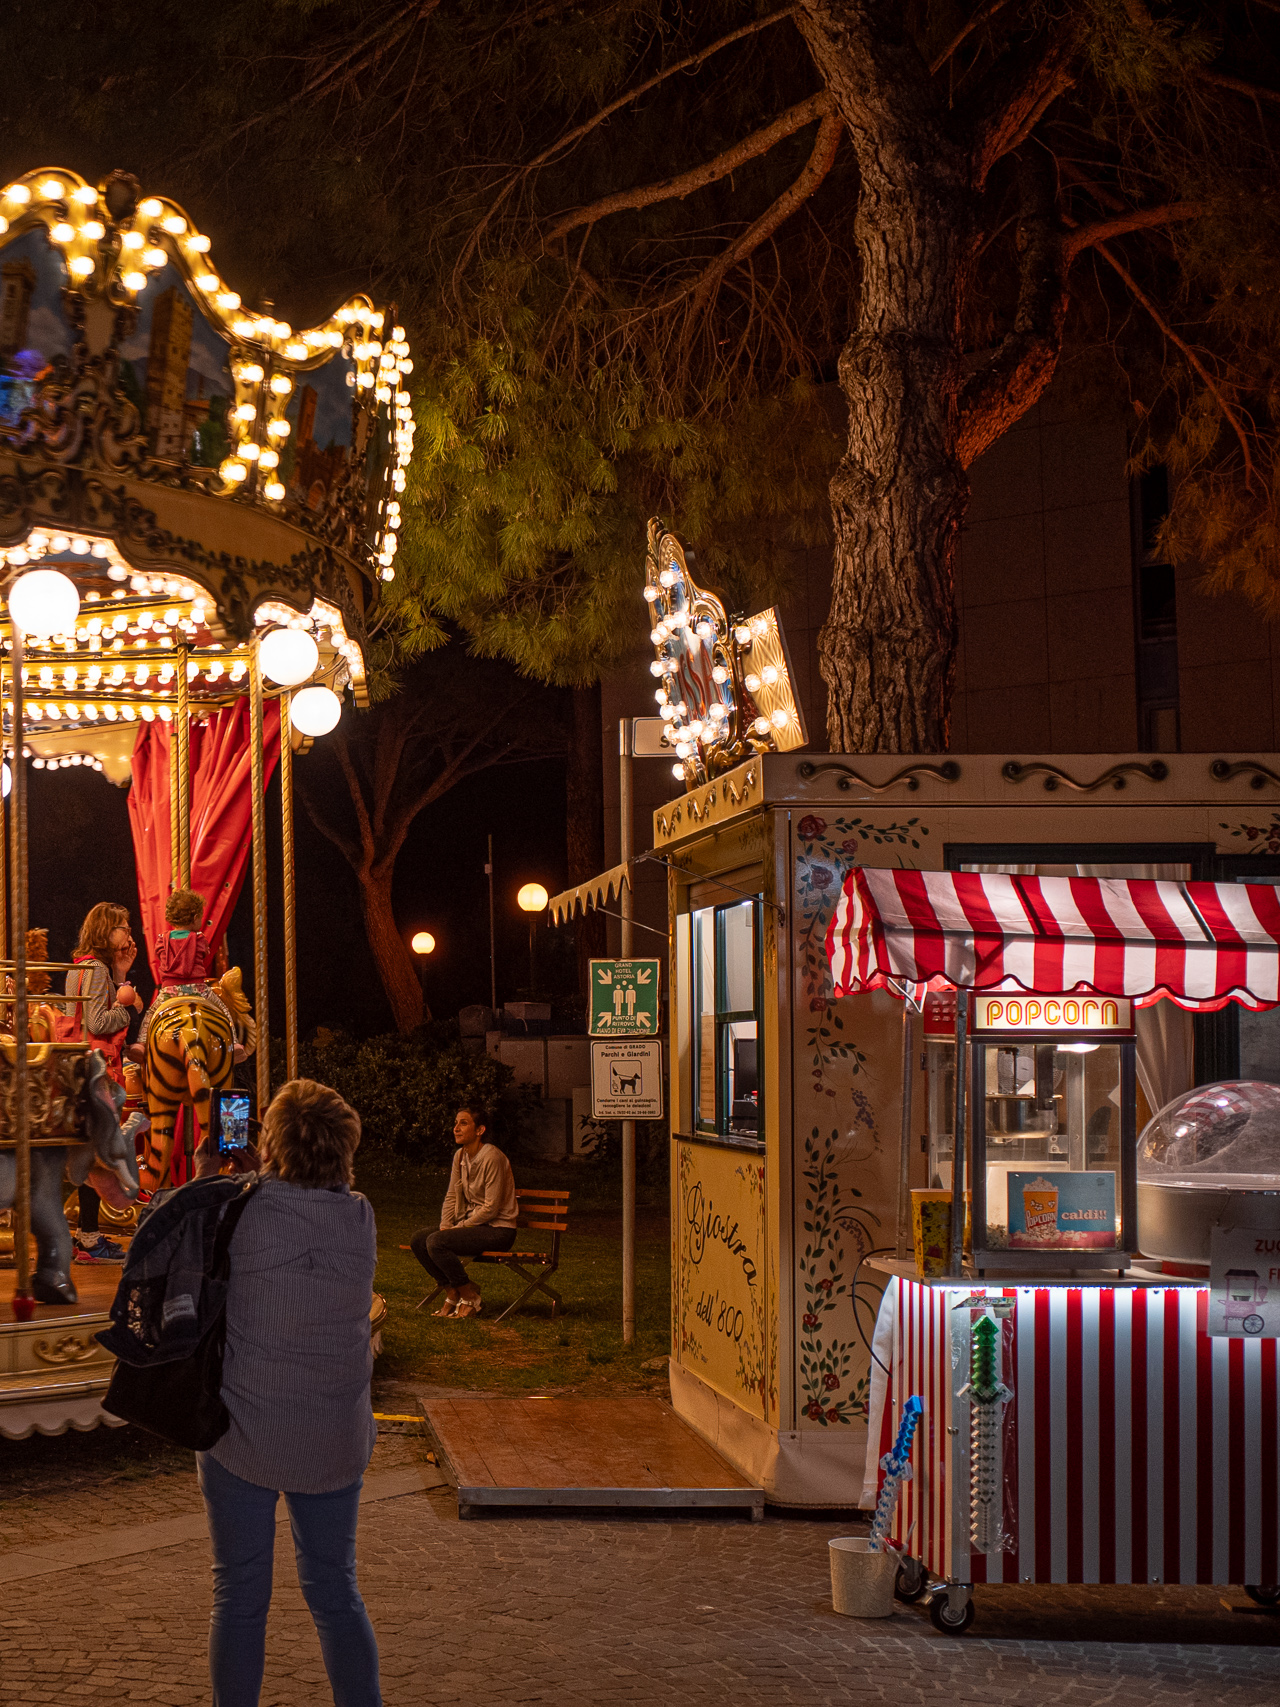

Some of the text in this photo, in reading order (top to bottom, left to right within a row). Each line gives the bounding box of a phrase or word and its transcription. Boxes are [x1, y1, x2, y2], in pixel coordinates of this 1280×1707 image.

[986, 999, 1119, 1026] POPCORN
[1061, 1209, 1108, 1220] caldi!!
[686, 1180, 758, 1287] Giostra
